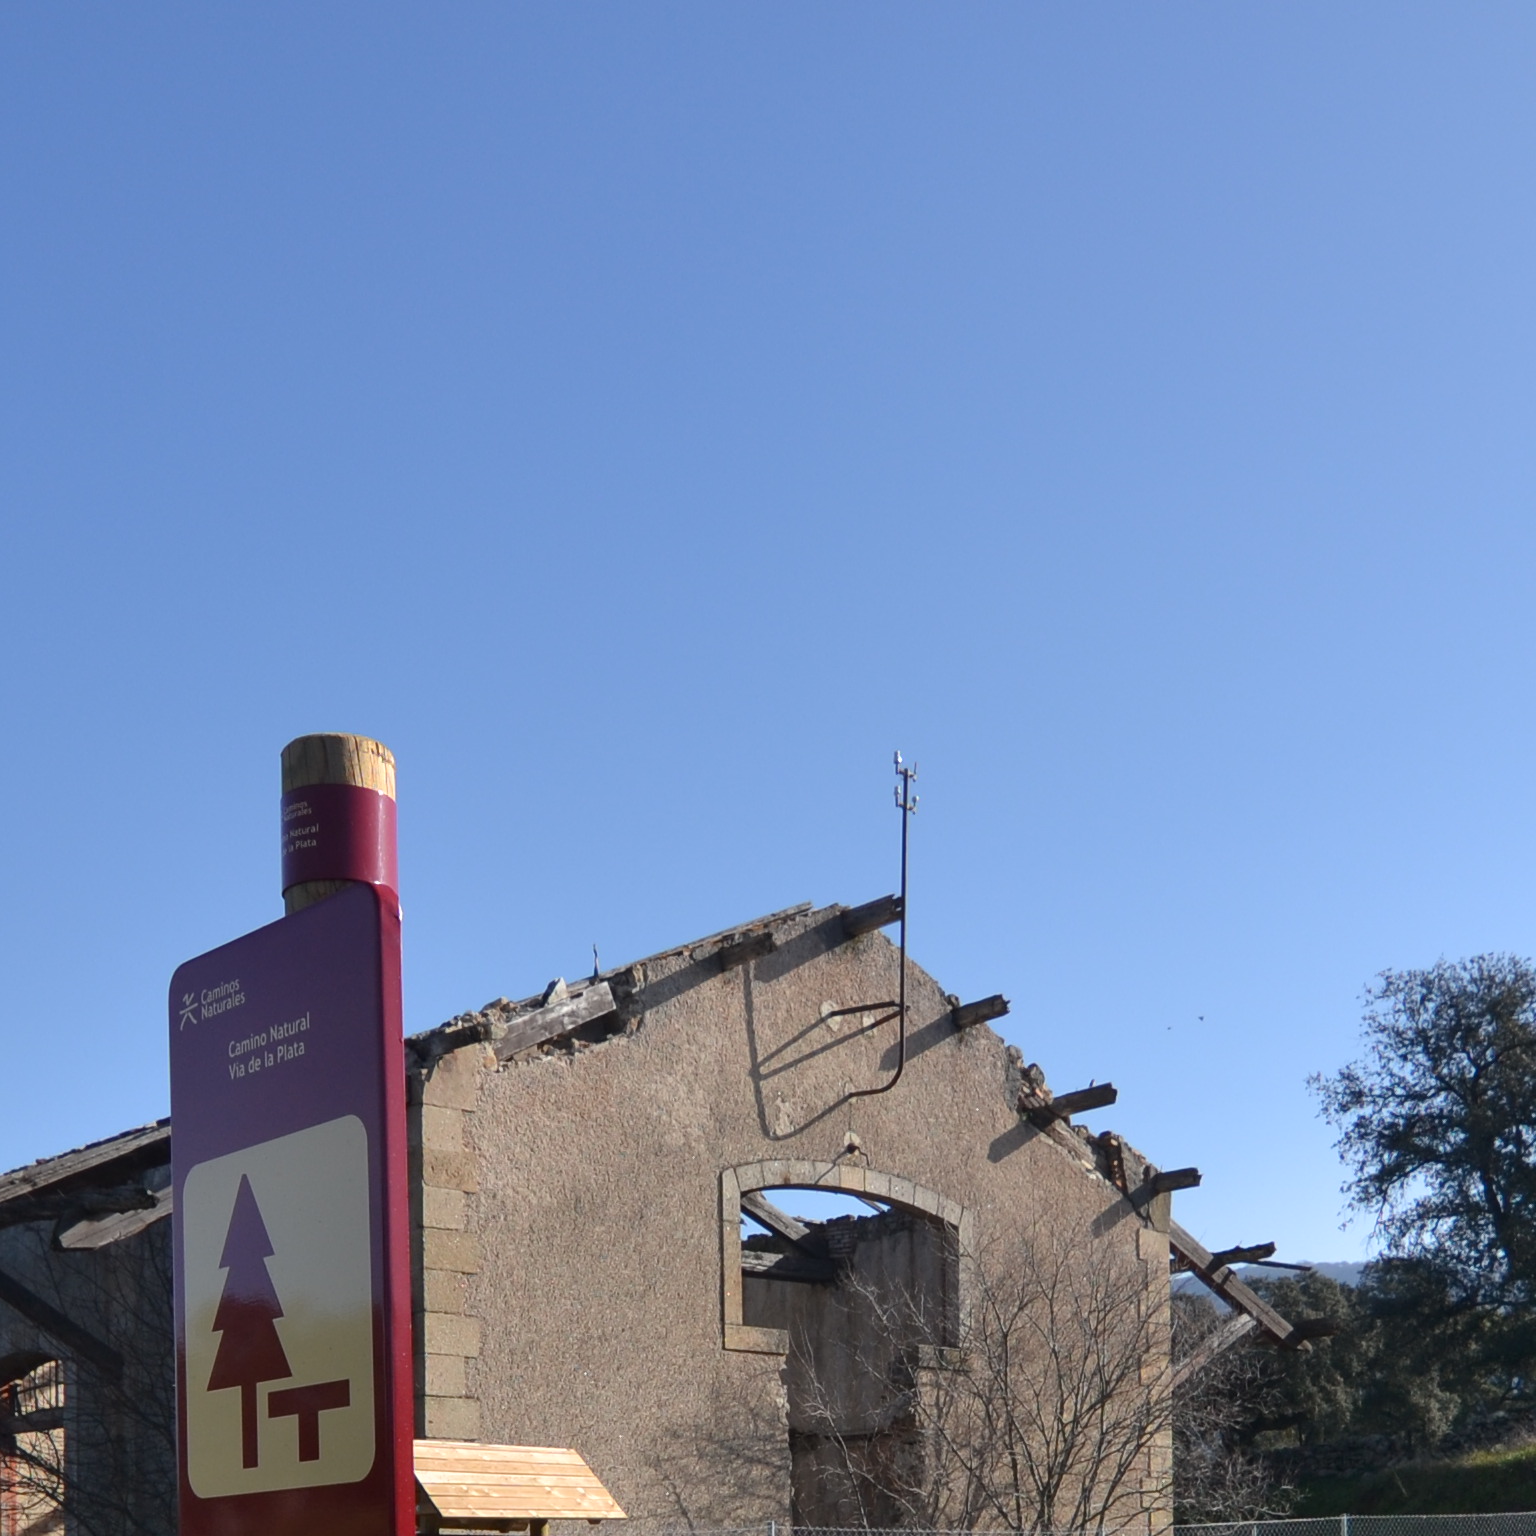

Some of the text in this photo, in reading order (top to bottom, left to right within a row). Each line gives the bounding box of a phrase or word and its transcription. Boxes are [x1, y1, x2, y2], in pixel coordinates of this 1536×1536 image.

[289, 822, 319, 838] Natural
[295, 838, 317, 850] Plata
[200, 978, 240, 1005] Caminos
[201, 991, 246, 1020] Naturales
[228, 1010, 310, 1058] Camino Natural
[248, 1055, 261, 1073] de
[264, 1050, 274, 1068] la
[277, 1041, 305, 1064] Plata
